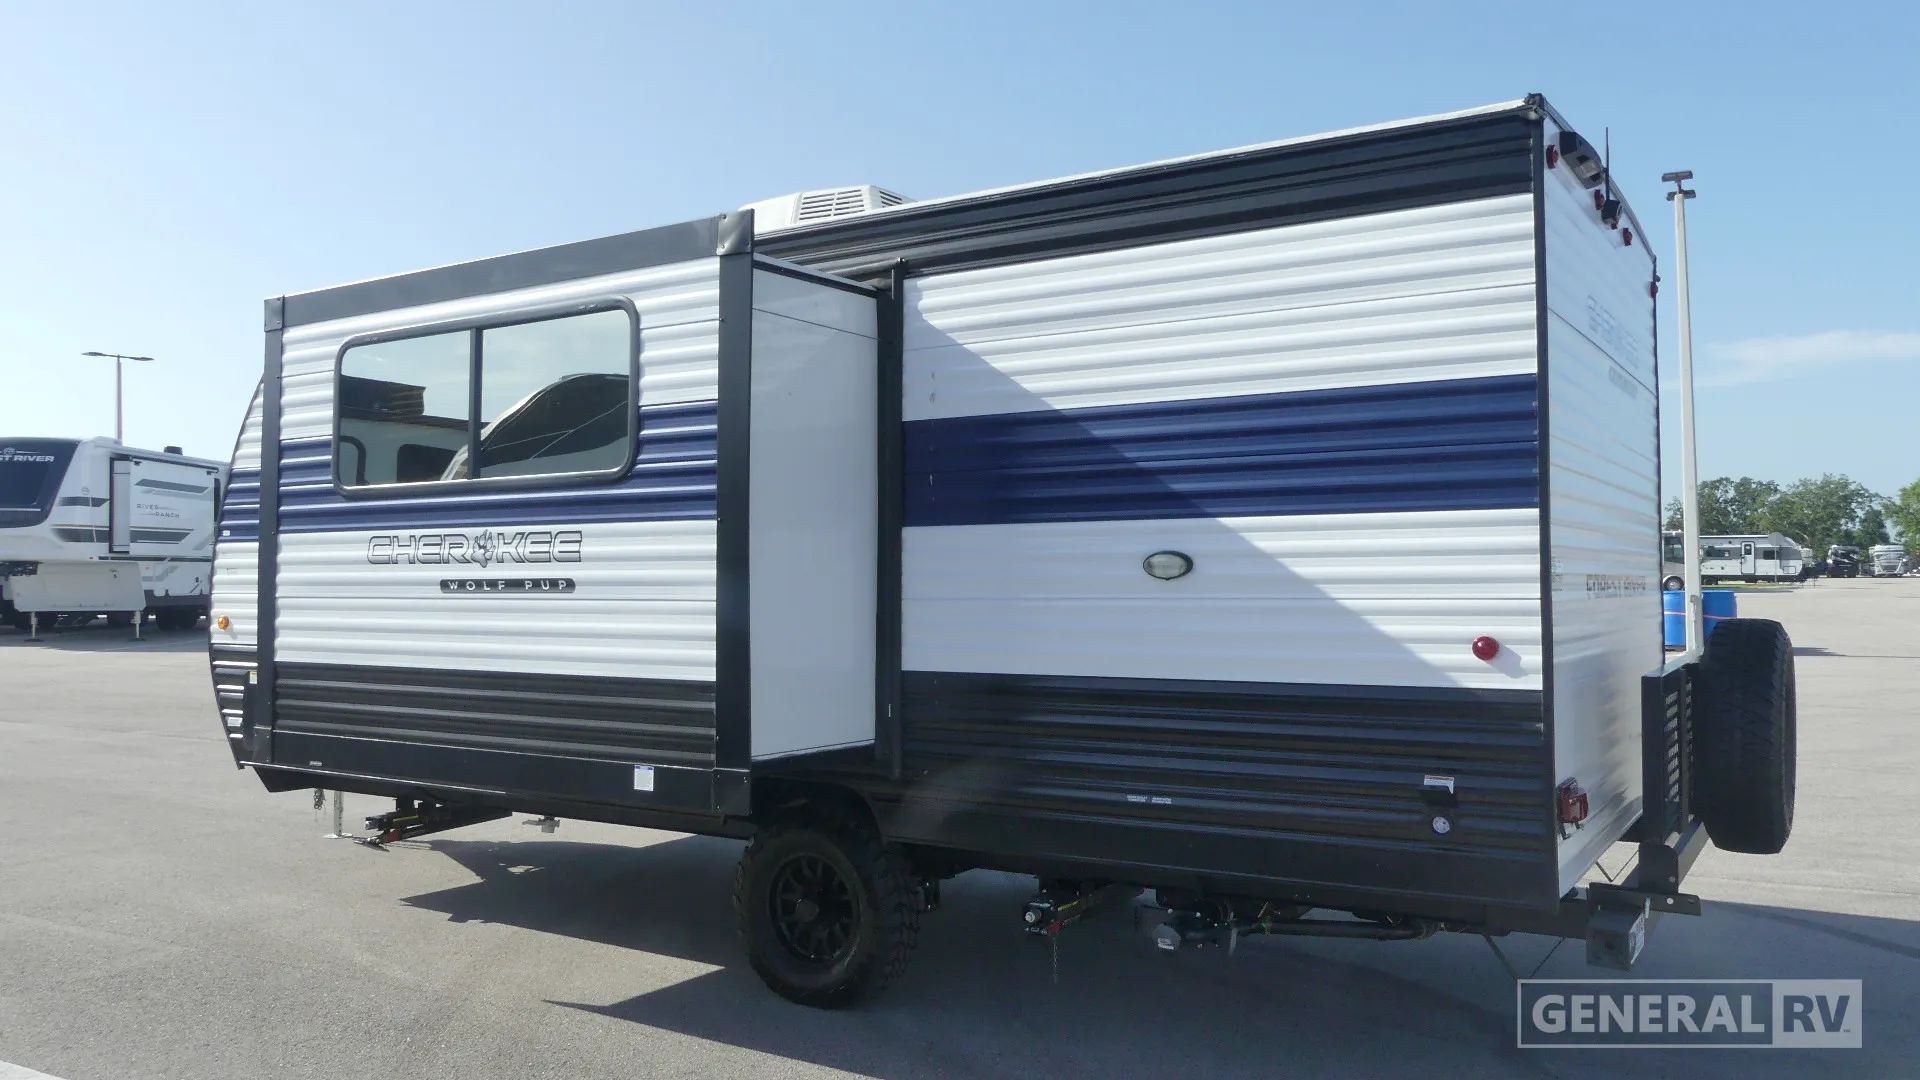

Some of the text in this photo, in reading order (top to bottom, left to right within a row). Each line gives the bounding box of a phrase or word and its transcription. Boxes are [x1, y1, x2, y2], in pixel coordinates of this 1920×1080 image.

[366, 530, 583, 567] CHEROKEE
[448, 580, 567, 591] WOLF PUP
